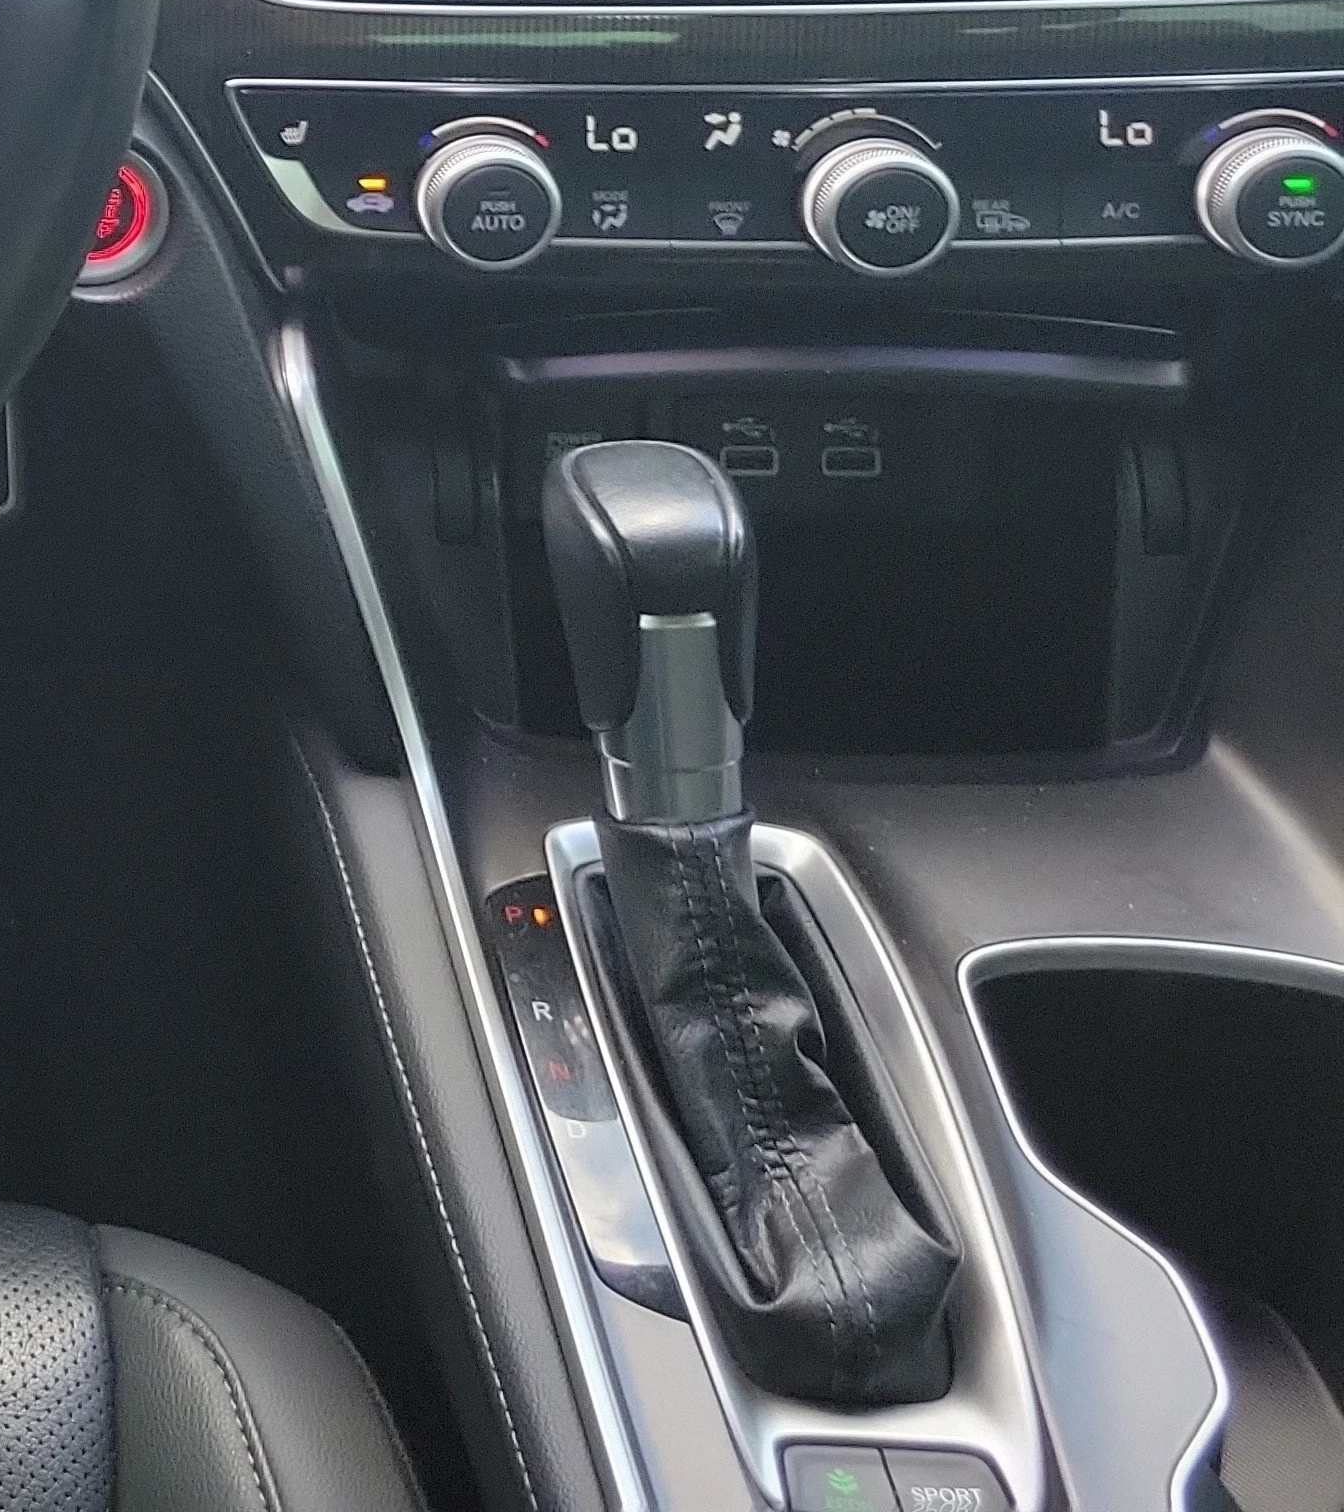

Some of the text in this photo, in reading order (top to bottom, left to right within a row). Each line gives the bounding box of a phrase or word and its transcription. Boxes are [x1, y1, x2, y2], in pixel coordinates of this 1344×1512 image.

[585, 115, 638, 151] Lo
[1098, 109, 1154, 146] Lo
[1101, 202, 1141, 219] A/C
[1267, 210, 1326, 227] SYNC
[471, 214, 526, 231] AUTO
[505, 905, 523, 923] P
[531, 1000, 553, 1021] R
[566, 1120, 587, 1140] D
[911, 1487, 981, 1505] SPORT
